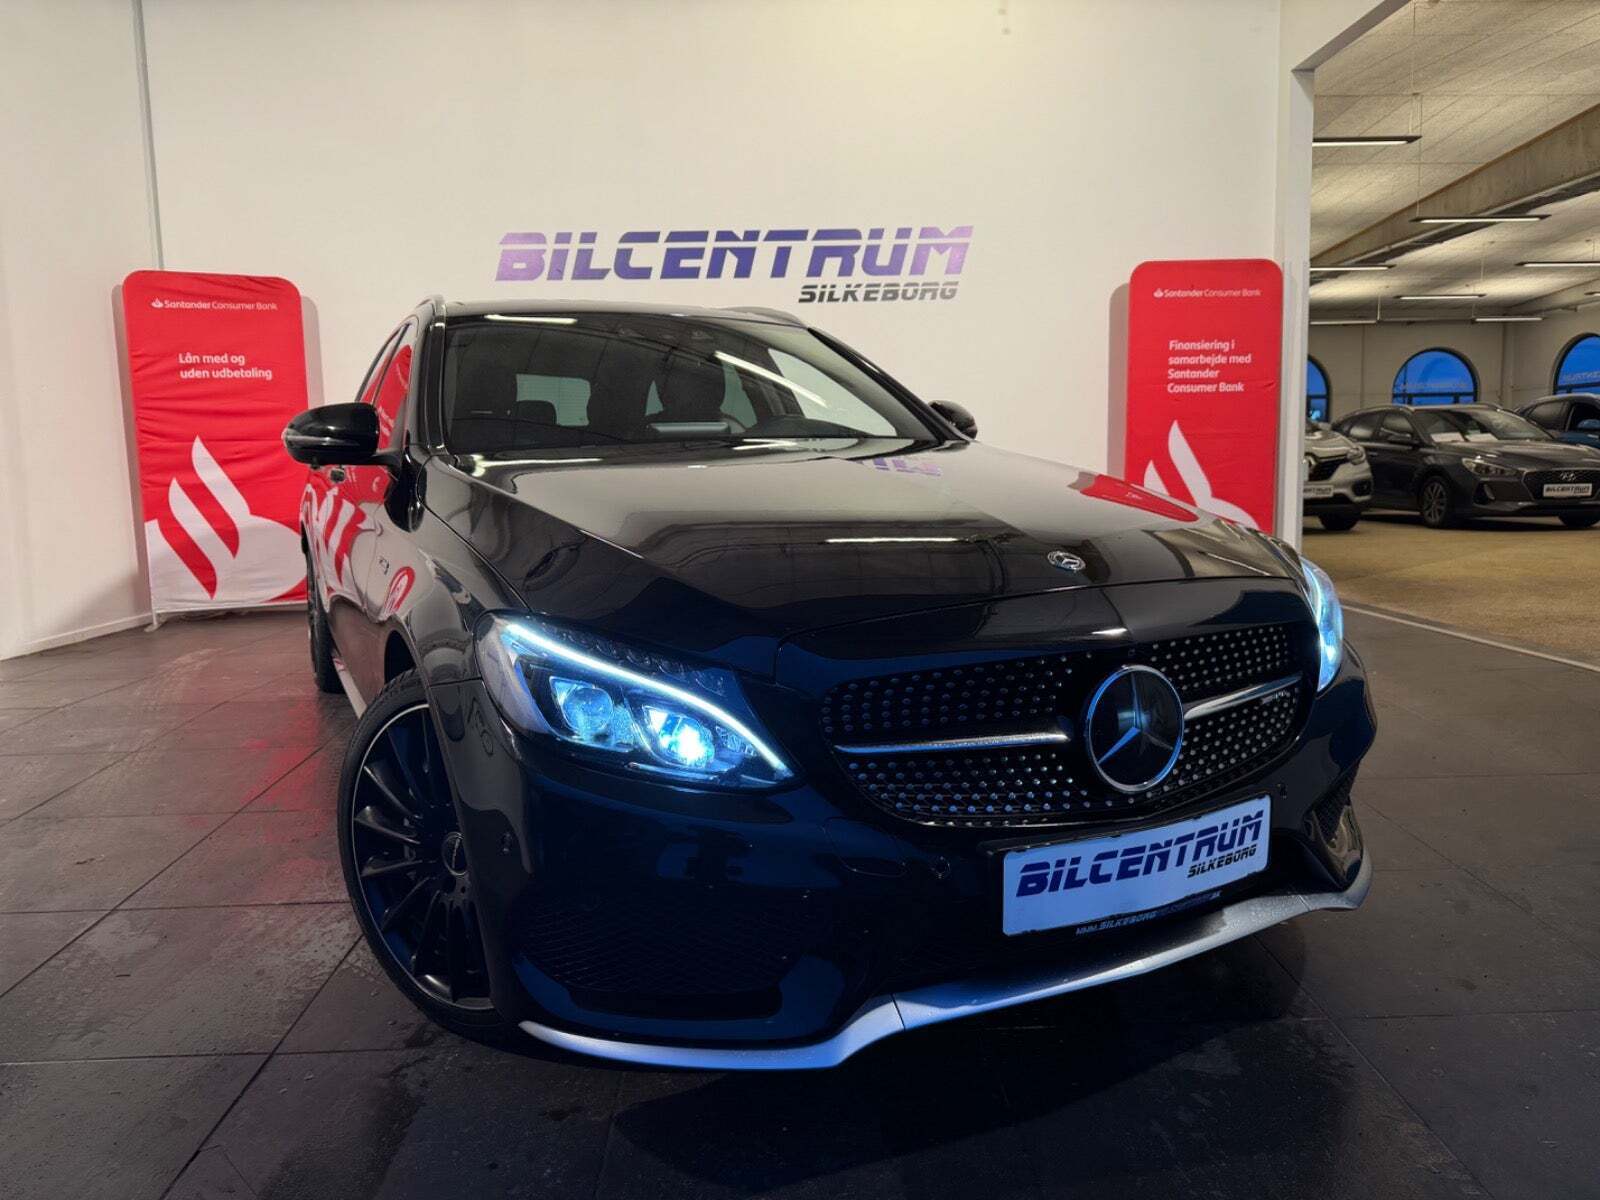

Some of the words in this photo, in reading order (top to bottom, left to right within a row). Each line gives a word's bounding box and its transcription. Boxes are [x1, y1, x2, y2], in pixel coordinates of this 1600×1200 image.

[495, 226, 974, 282] BILCENTRUM
[799, 281, 959, 303] SILKEBORG
[1164, 289, 1203, 297] Santander
[1204, 289, 1241, 297] Consumer
[1242, 288, 1261, 297] Bank
[164, 299, 210, 309] Santander
[211, 301, 255, 310] Consumer
[256, 302, 277, 311] Bank
[1169, 339, 1230, 352] Finansiering
[1231, 339, 1236, 350] i
[179, 352, 200, 364] Lån
[202, 353, 228, 364] med
[230, 355, 245, 366] og
[1168, 354, 1227, 367] samarbejde
[1229, 353, 1252, 364] med
[180, 368, 209, 379] uden
[212, 368, 273, 381] udbetaling
[1168, 368, 1220, 379] Santander
[1167, 382, 1217, 393] Consumer
[1219, 381, 1244, 393] Bank
[1016, 810, 1264, 897] BILCENTRUM
[1187, 844, 1257, 879] SILKEBORG
